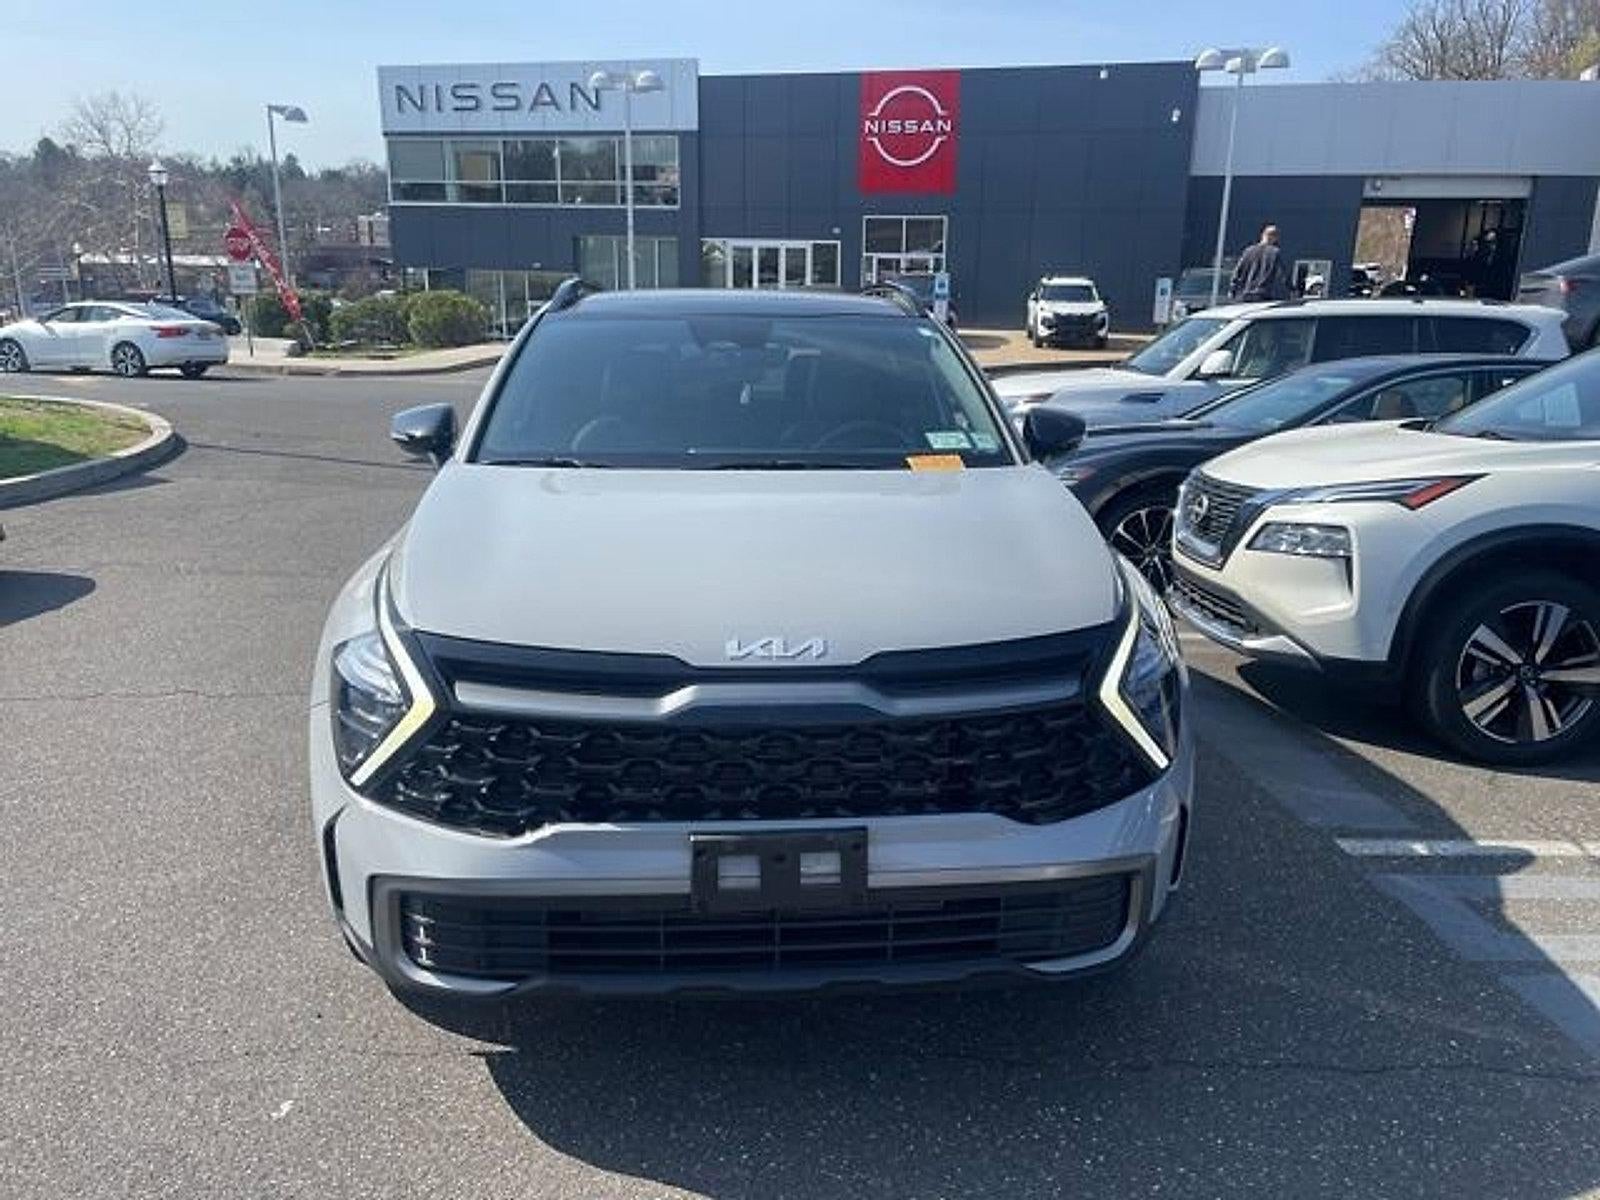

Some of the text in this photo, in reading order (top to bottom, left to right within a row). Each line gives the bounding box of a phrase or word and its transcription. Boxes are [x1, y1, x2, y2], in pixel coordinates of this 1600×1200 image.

[394, 82, 601, 113] NISSAN
[864, 119, 952, 134] NISSAN
[724, 637, 827, 661] KIA
